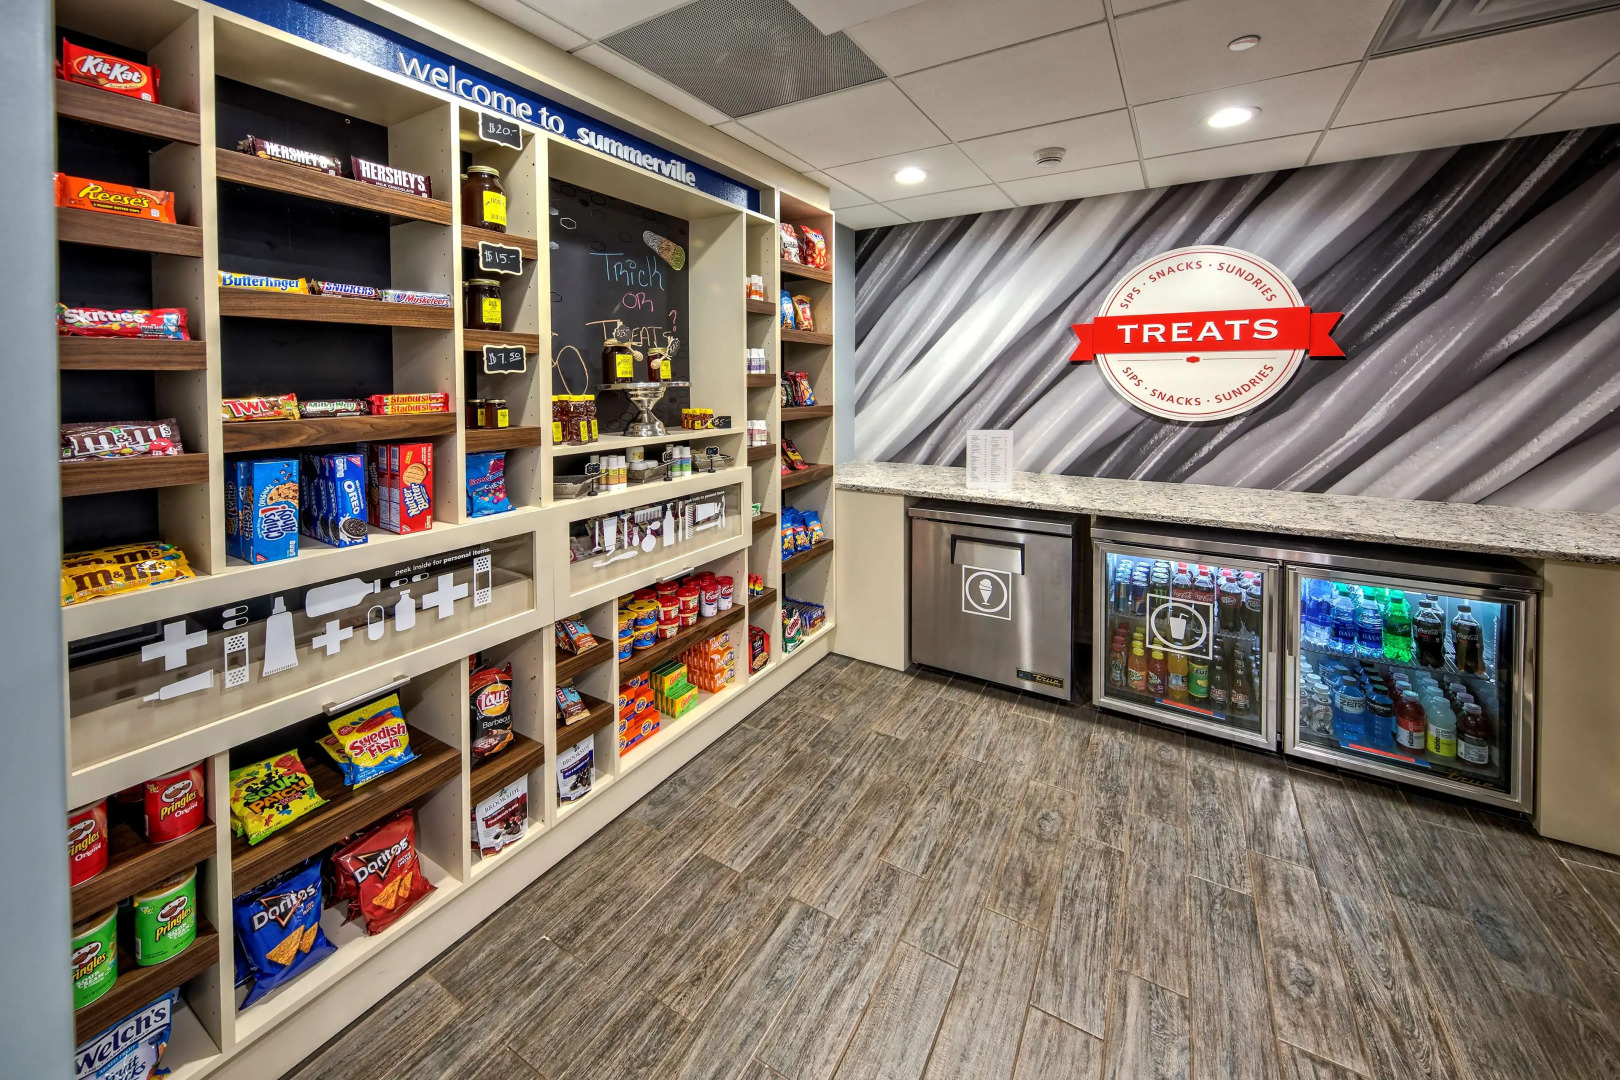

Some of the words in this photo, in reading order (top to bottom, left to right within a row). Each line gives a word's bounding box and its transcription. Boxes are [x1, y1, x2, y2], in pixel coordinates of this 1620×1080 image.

[398, 52, 533, 123] welcome
[538, 106, 565, 134] to
[576, 127, 696, 187] summerville
[360, 160, 426, 192] HERSHEY'S
[79, 184, 150, 208] Reese's
[221, 272, 300, 290] Butterfinger
[324, 281, 375, 296] SNICKERS
[1120, 287, 1141, 310] SIPS
[1148, 260, 1203, 283] SNACKS
[1217, 262, 1278, 303] SUNDRIES
[64, 309, 146, 324] Skittles
[1117, 318, 1279, 344] TREATS
[1122, 366, 1142, 388] SIPS
[1149, 388, 1201, 406] SNACKS
[1214, 364, 1274, 404] SUNDRIES
[343, 480, 360, 515] OREO
[262, 512, 285, 540] Chips
[395, 566, 411, 576] peek
[413, 561, 431, 570] inside
[443, 552, 471, 564] personal
[472, 547, 491, 556] items.
[348, 722, 406, 758] Swedish
[367, 737, 400, 759] Fish
[244, 773, 299, 802] SOUR
[249, 779, 309, 814] PATCH
[484, 787, 520, 813] BROOKSIDE
[160, 791, 197, 821] Pringles
[69, 831, 100, 857] ringles
[355, 838, 411, 883] Doritos
[252, 884, 317, 931] Doritos
[155, 906, 191, 942] Pringles
[71, 951, 107, 982] ringles
[75, 1006, 167, 1076] Welch's
